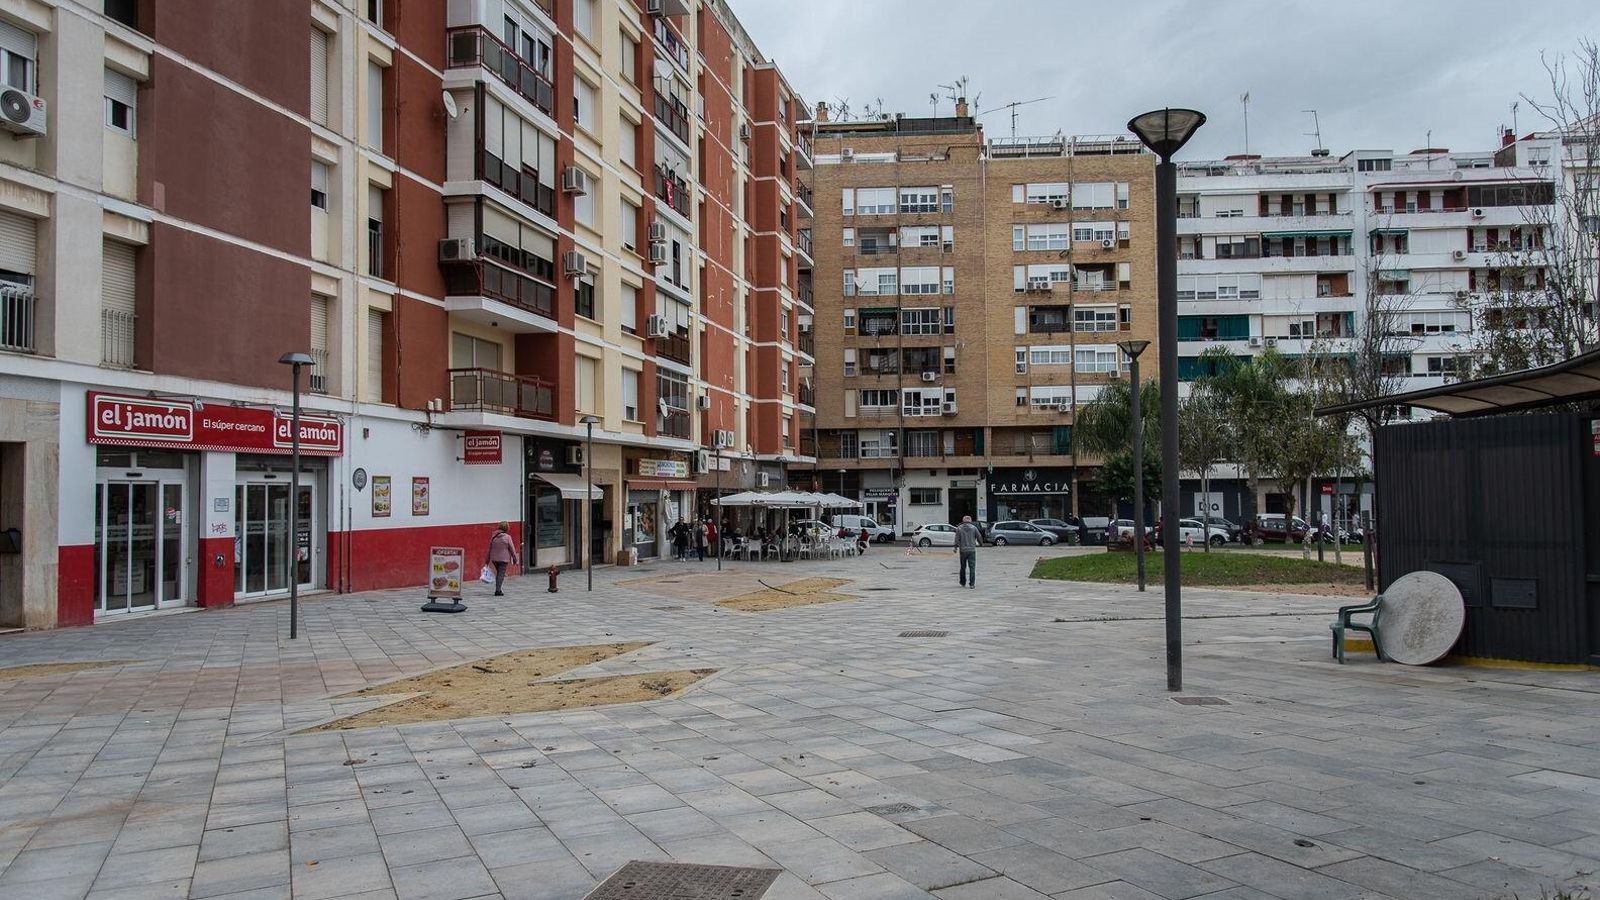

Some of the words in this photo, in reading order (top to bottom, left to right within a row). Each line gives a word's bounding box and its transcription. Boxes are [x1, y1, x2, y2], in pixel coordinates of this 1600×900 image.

[101, 404, 121, 425] el
[124, 405, 187, 431] jamón
[203, 419, 211, 429] El
[212, 420, 234, 431] súper
[235, 423, 265, 433] cercano
[278, 420, 292, 437] el
[297, 421, 336, 441] amón
[468, 438, 475, 446] el
[475, 437, 497, 447] jamón
[991, 483, 1069, 492] FARMACIA
